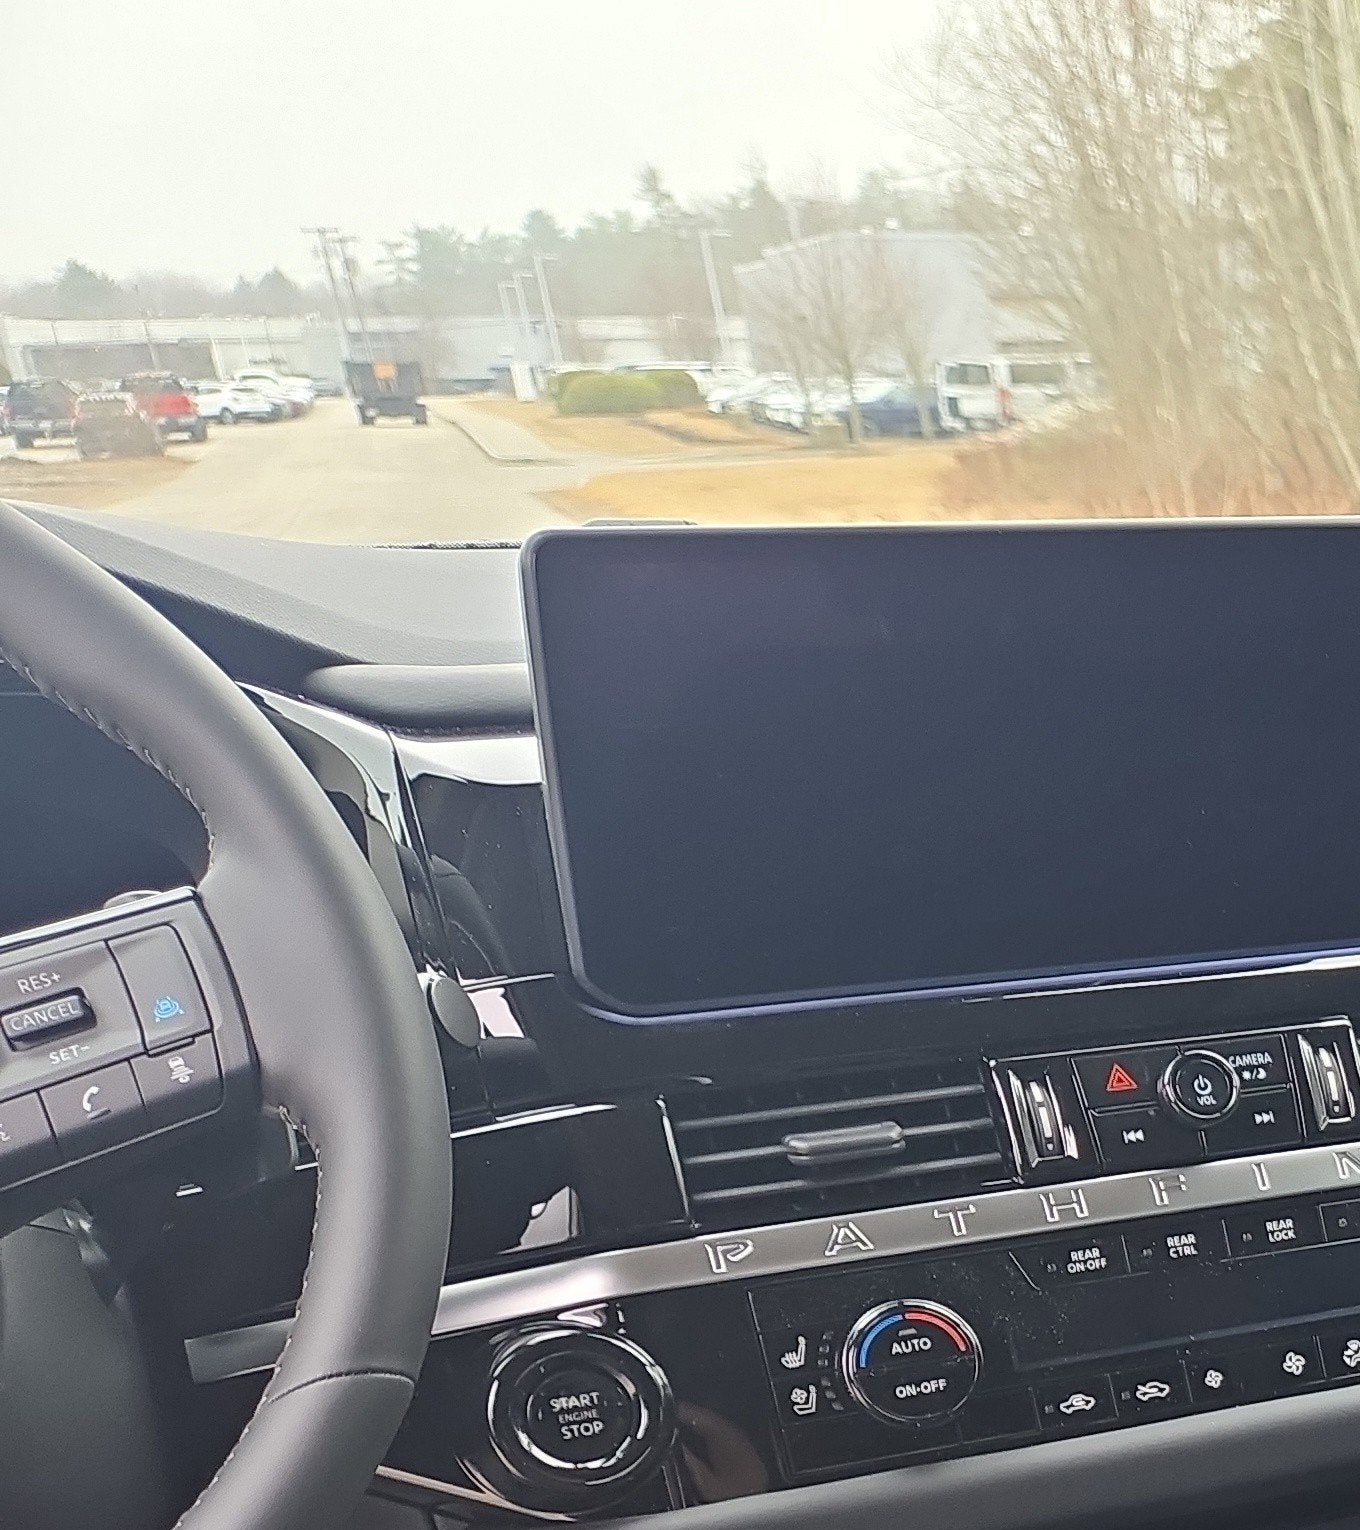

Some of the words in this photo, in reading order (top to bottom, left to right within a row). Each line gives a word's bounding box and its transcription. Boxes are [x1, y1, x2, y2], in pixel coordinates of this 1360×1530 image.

[17, 972, 61, 994] RES+
[11, 1002, 79, 1031] CANCEL
[1228, 1052, 1273, 1068] CAMERA
[1197, 1095, 1217, 1106] VOL
[1266, 1218, 1294, 1232] REAR
[1167, 1233, 1196, 1247] REAR
[1268, 1229, 1297, 1243] LOCK
[1070, 1248, 1100, 1262] REAR
[1169, 1245, 1198, 1258] CTRL
[891, 1337, 932, 1355] AUTO
[549, 1391, 600, 1412] START
[559, 1408, 599, 1423] ENGINE
[561, 1421, 604, 1440] STOP
